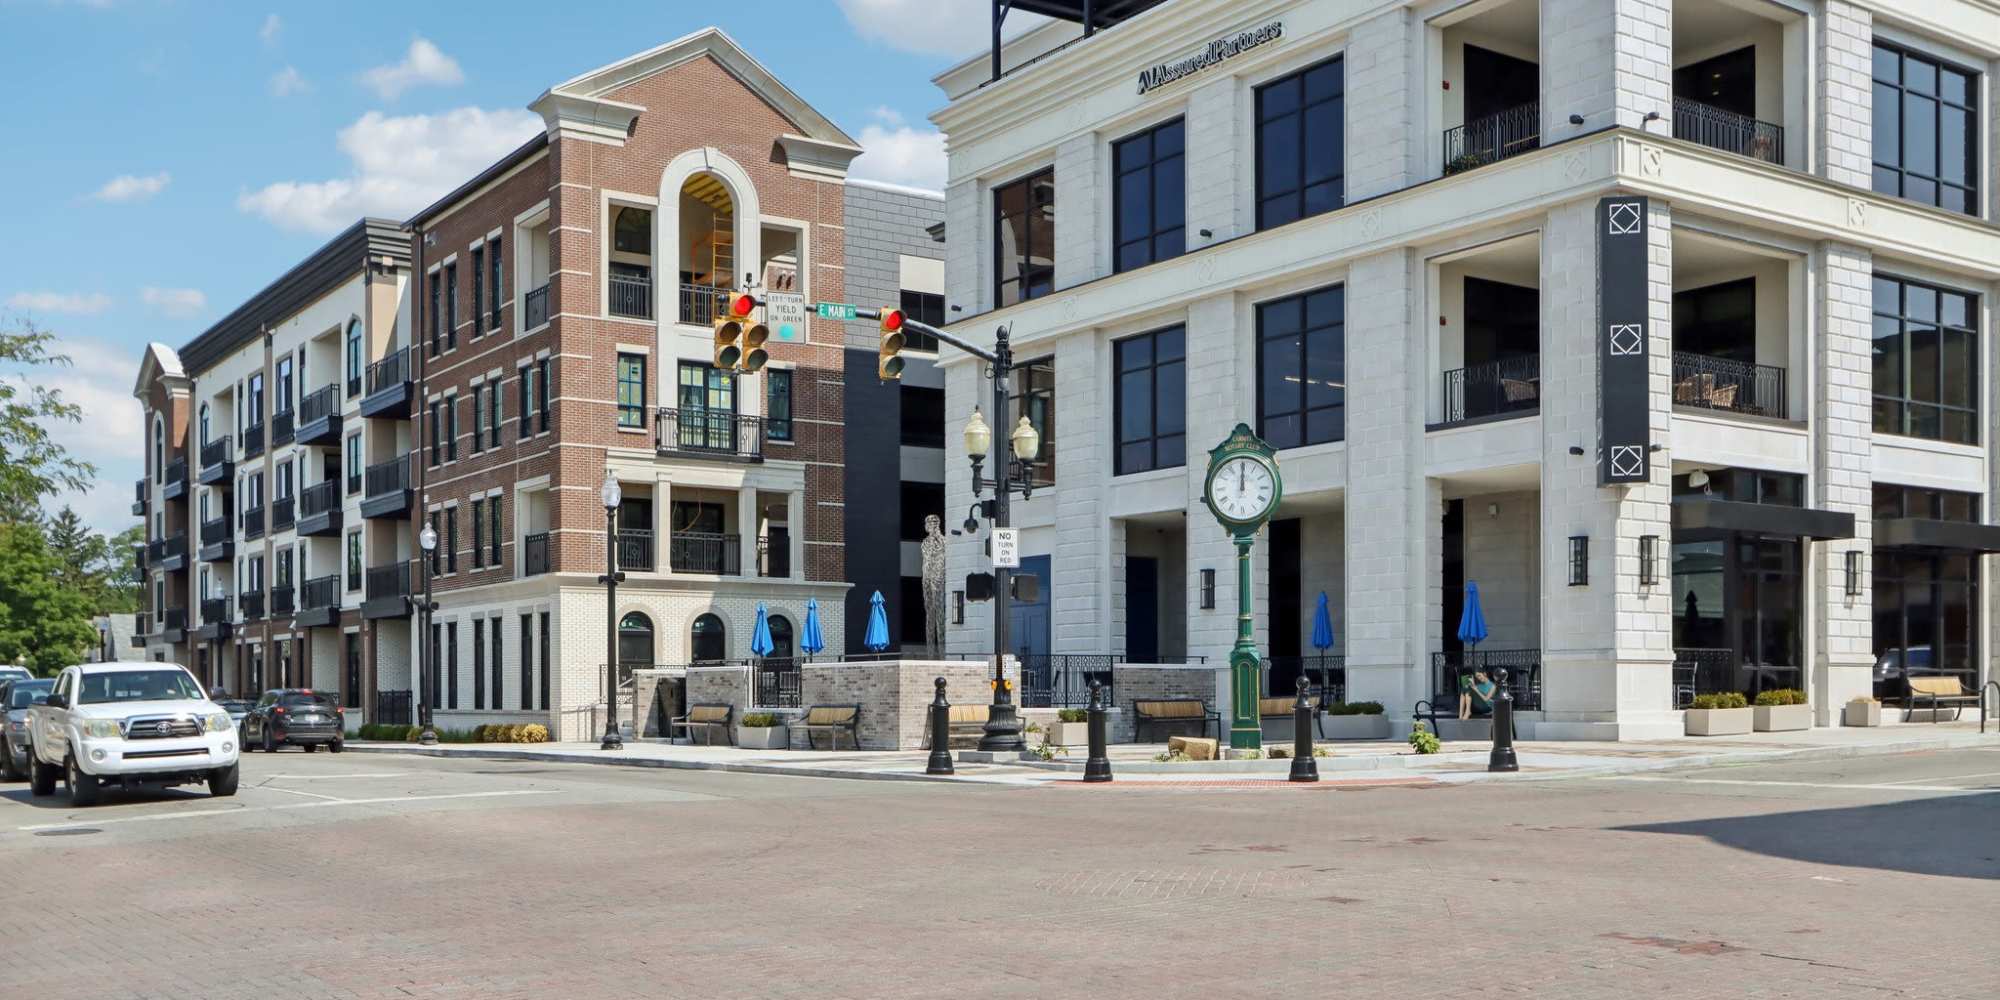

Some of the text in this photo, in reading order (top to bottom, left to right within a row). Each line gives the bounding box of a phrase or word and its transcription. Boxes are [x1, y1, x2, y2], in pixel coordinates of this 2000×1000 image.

[787, 296, 803, 304] TURN
[775, 305, 797, 314] YIELD
[820, 305, 826, 316] E
[828, 306, 846, 318] MAIN
[999, 532, 1012, 540] NO
